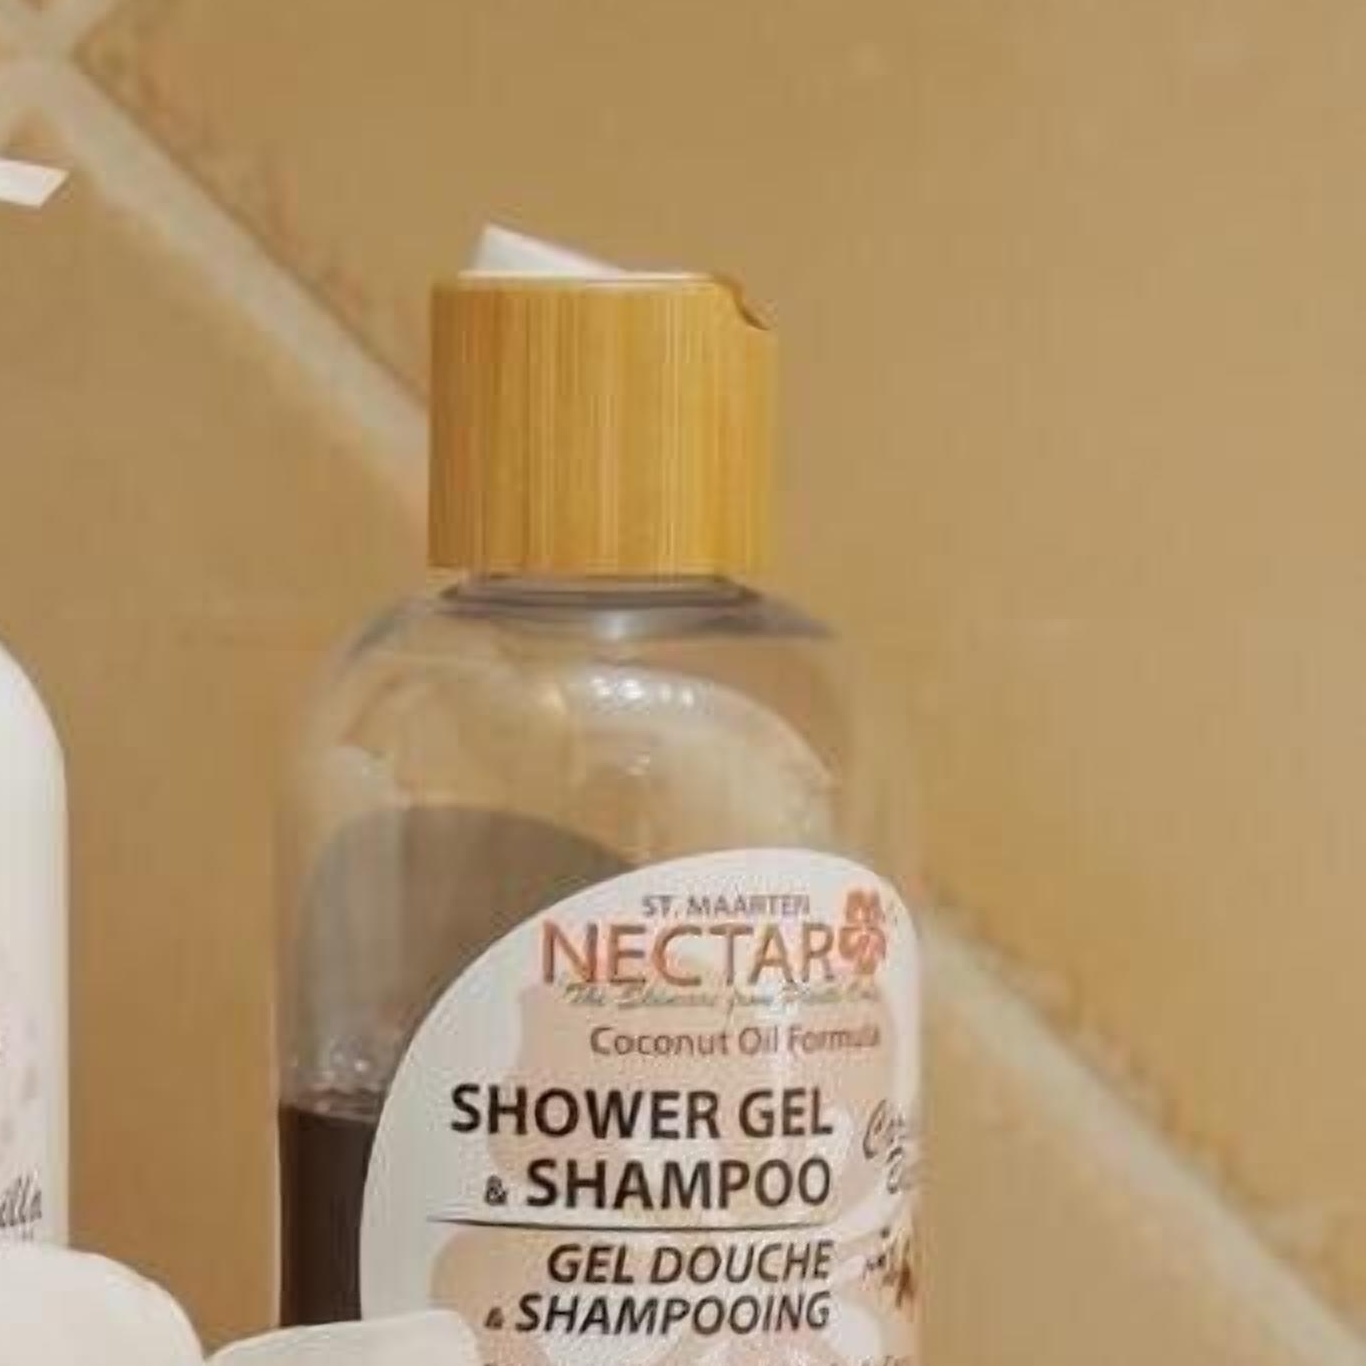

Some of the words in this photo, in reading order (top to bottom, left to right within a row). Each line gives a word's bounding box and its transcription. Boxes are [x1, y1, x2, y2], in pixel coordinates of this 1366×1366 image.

[686, 894, 811, 917] MAARTEN
[540, 919, 834, 987] NECTAR
[589, 1026, 727, 1058] Coconut
[738, 1025, 779, 1054] Oil
[451, 1083, 721, 1139] SHOWER
[738, 1087, 833, 1139] GEL
[484, 1175, 509, 1208] &
[526, 1157, 832, 1211] SHAMPOO
[547, 1244, 636, 1286] GEL
[650, 1239, 834, 1286] DOUCHE
[515, 1291, 832, 1337] SHAMPOOING
